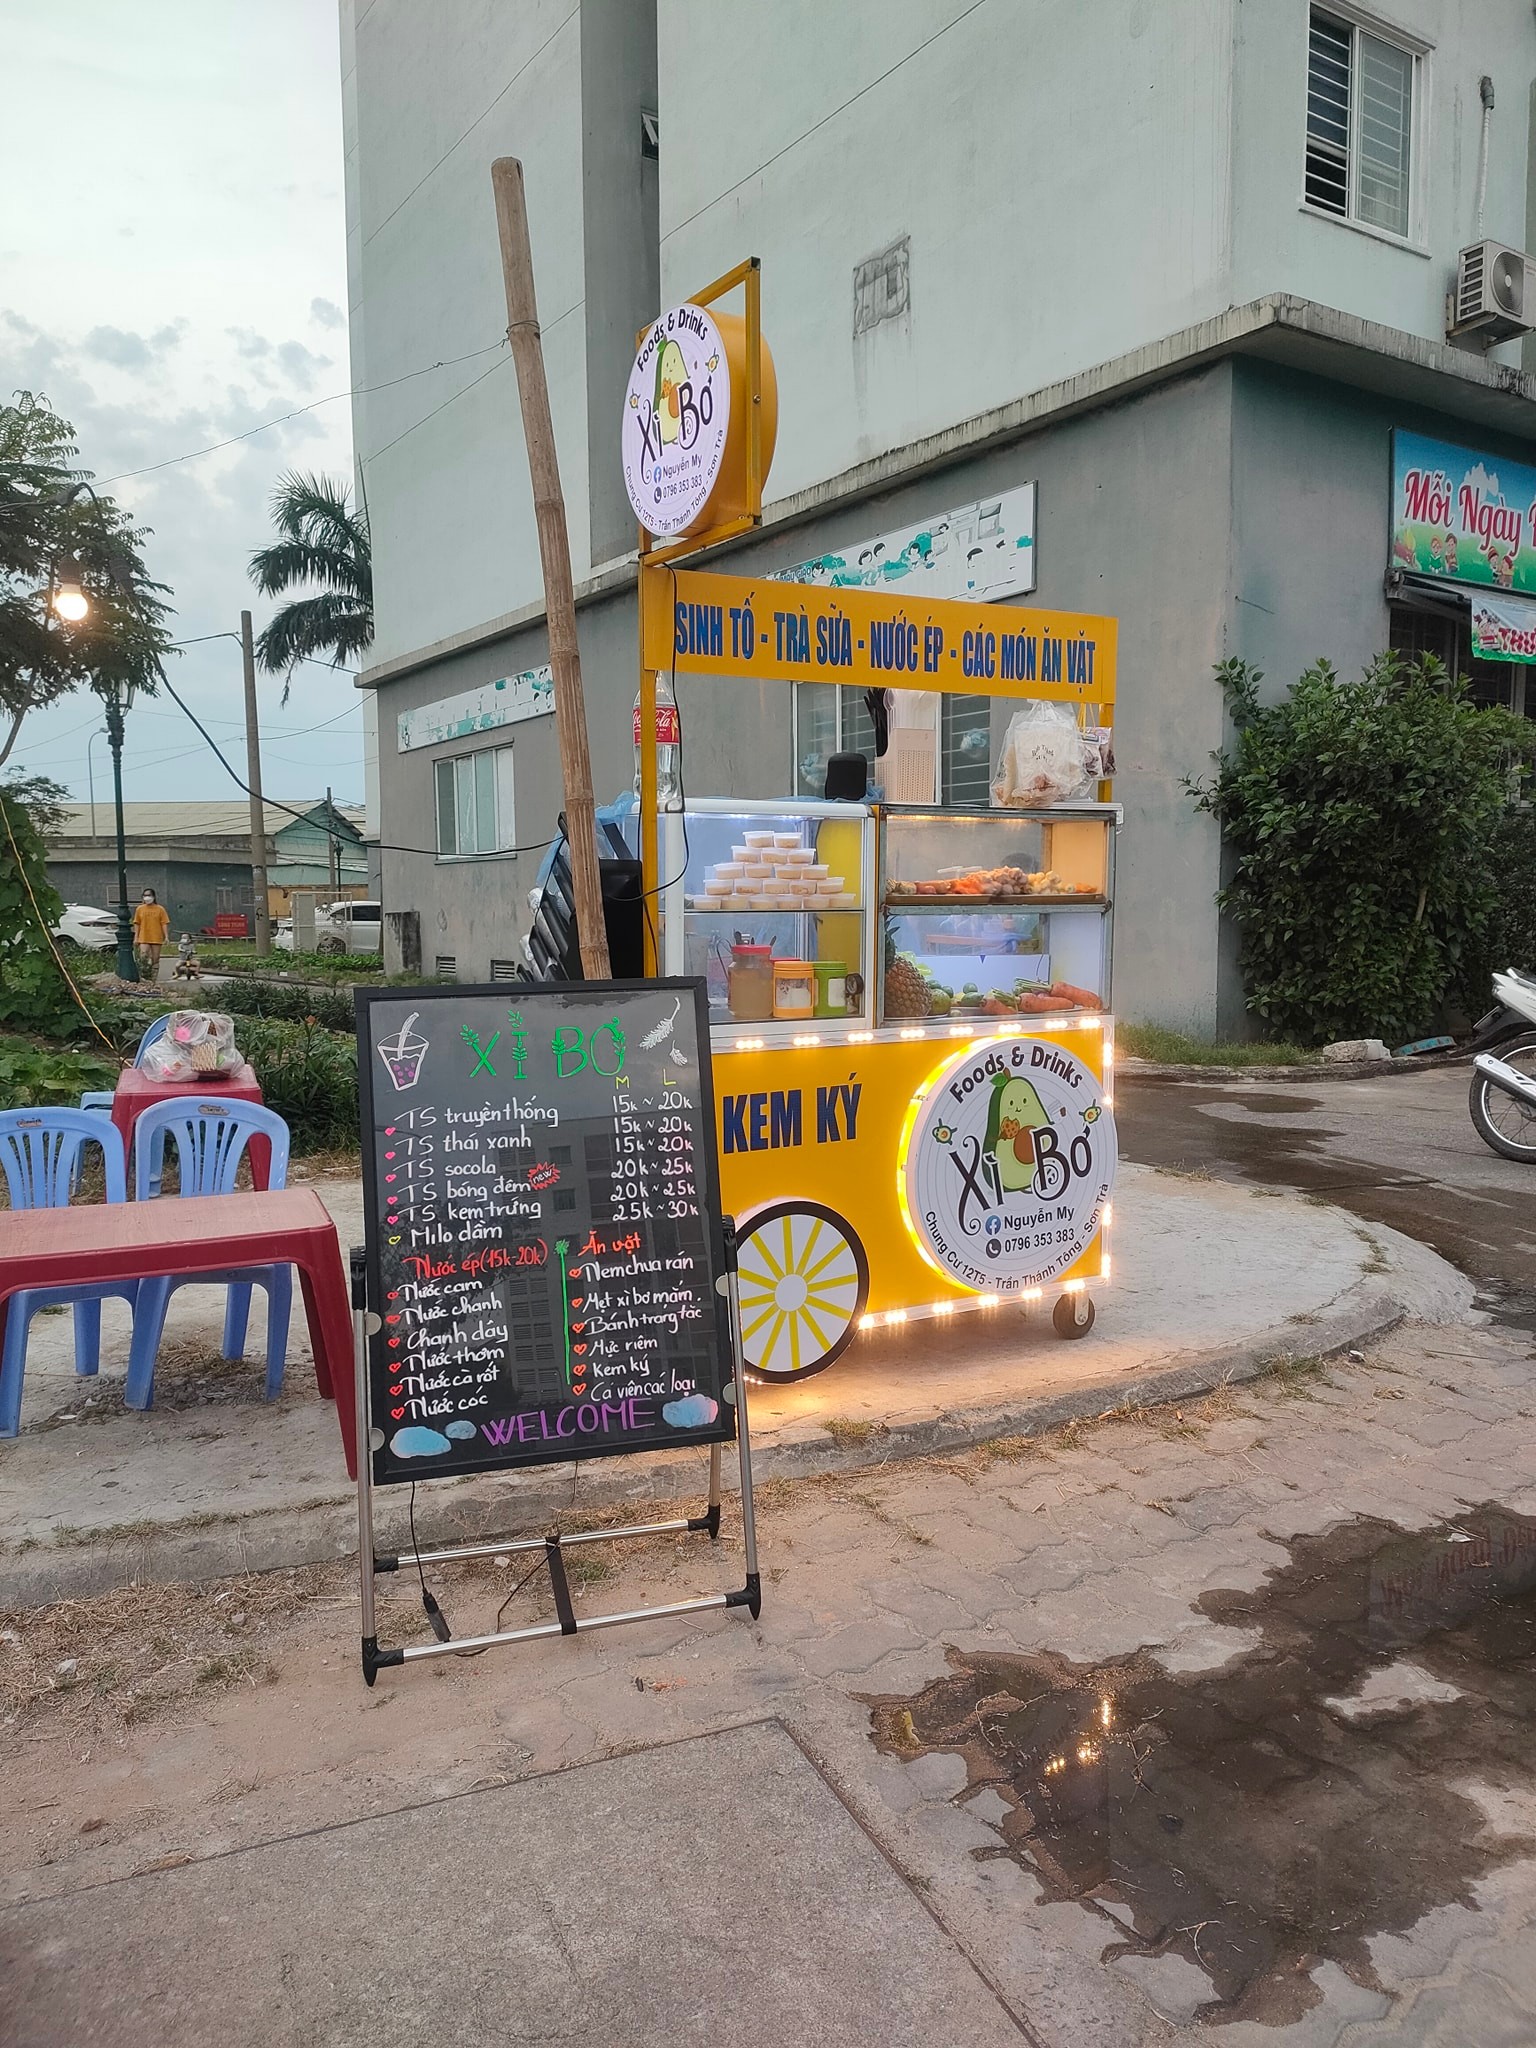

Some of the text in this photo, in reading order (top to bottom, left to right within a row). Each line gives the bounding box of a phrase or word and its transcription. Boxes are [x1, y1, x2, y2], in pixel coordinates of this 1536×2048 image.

[637, 308, 708, 372] Foods & Drinks
[663, 457, 690, 479] Nguyễn
[625, 465, 637, 502] Chung
[641, 510, 655, 527] 12T5
[662, 474, 702, 499] 0796 353 383
[1404, 471, 1454, 528] Mỗi
[1459, 485, 1522, 557] Ngày
[676, 601, 723, 657] SINH
[729, 591, 755, 660] TỐ
[774, 604, 811, 663] TRÀ
[816, 602, 853, 667] SỮA
[870, 609, 918, 672] NƯỚC
[924, 615, 943, 673] ÉP
[962, 623, 995, 679] CÁC
[1000, 627, 1036, 681] MÓN
[1041, 626, 1062, 683] ĂN
[1067, 630, 1096, 694] VẶT
[615, 1068, 677, 1090] M L
[949, 1045, 1083, 1104] Foods & Drinks
[394, 1095, 559, 1129] TS truyền thống
[613, 1094, 638, 1113] 15k
[658, 1091, 693, 1110] 20k
[723, 1071, 863, 1155] KEM KÝ
[614, 1116, 642, 1134] 15k
[658, 1116, 693, 1134] 20k
[394, 1123, 532, 1156] TS thái xanh
[615, 1136, 645, 1154] 15k
[658, 1136, 694, 1152] 20k
[392, 1154, 496, 1179] TS socola
[532, 1169, 554, 1184] new
[611, 1158, 649, 1179] 20k
[661, 1156, 693, 1176] 25k
[397, 1175, 531, 1203] TS bóng đêm
[610, 1181, 649, 1201] 20k
[663, 1180, 696, 1196] 25k
[397, 1196, 542, 1222] TS kem trứng
[612, 1201, 654, 1221] 25k
[667, 1200, 699, 1219] 30k
[1004, 1206, 1075, 1231] Nguyễn My
[411, 1222, 453, 1248] Milo
[578, 1230, 642, 1257] Ăn vặt
[926, 1211, 948, 1255] Chung
[947, 1251, 963, 1269] Cư
[962, 1264, 987, 1285] 12T5
[995, 1275, 1019, 1290] Trần
[1022, 1264, 1056, 1286] Thánh
[1055, 1240, 1083, 1267] Tông
[1083, 1208, 1101, 1233] Sơn
[1095, 1183, 1109, 1204] Trà
[1004, 1228, 1075, 1253] 0796 353 383
[665, 1250, 694, 1270] rán
[444, 1280, 483, 1295] cam
[452, 1292, 503, 1316] chanh
[407, 1320, 509, 1350] Chanh dây
[452, 1346, 505, 1365] thơm
[592, 1353, 650, 1378] Kem ký
[453, 1369, 473, 1386] cà
[476, 1361, 500, 1383] rốt
[458, 1385, 488, 1410] cóc
[617, 1379, 643, 1399] viên
[480, 1398, 656, 1446] WELCOME
